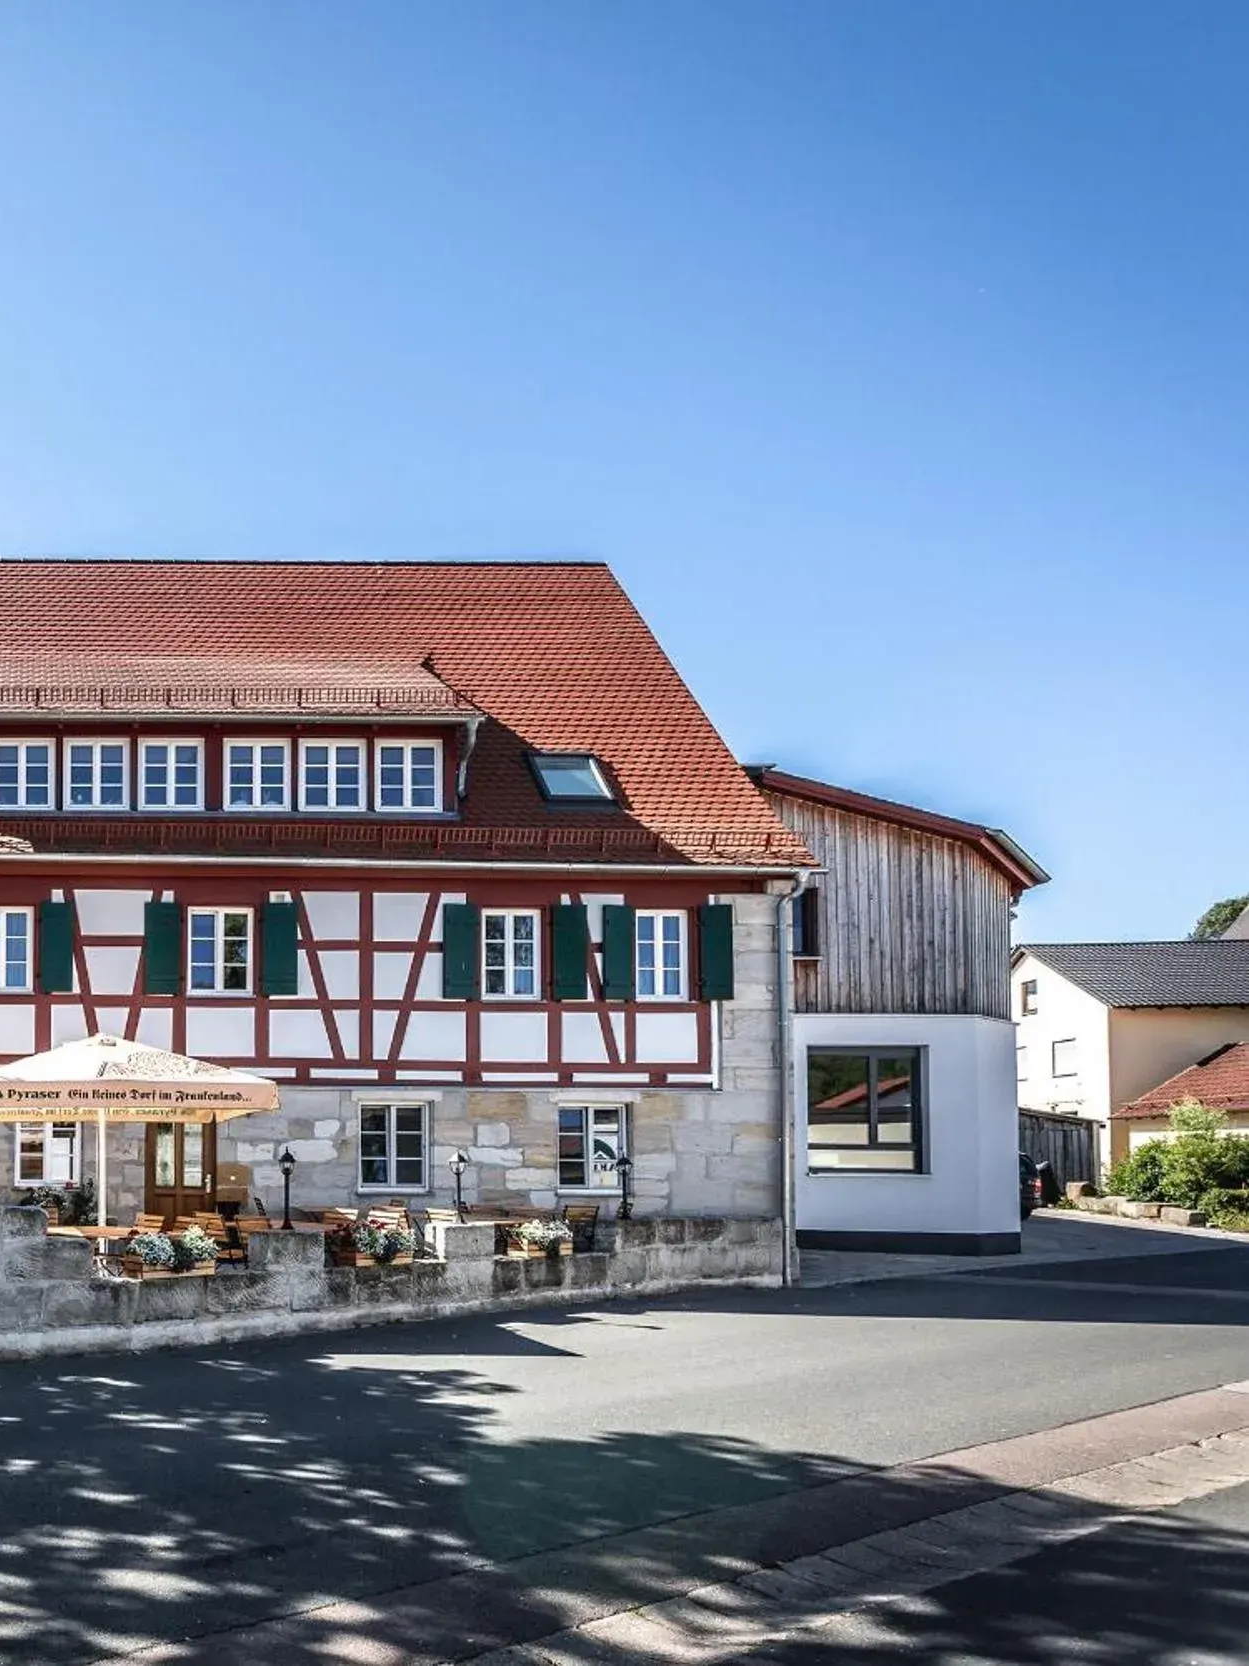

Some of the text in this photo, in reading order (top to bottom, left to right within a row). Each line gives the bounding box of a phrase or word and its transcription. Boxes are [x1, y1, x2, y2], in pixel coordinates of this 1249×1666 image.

[7, 1089, 61, 1102] Pyraser
[68, 1089, 89, 1099] Ein
[129, 1088, 156, 1103] Dorf
[158, 1089, 172, 1100] im
